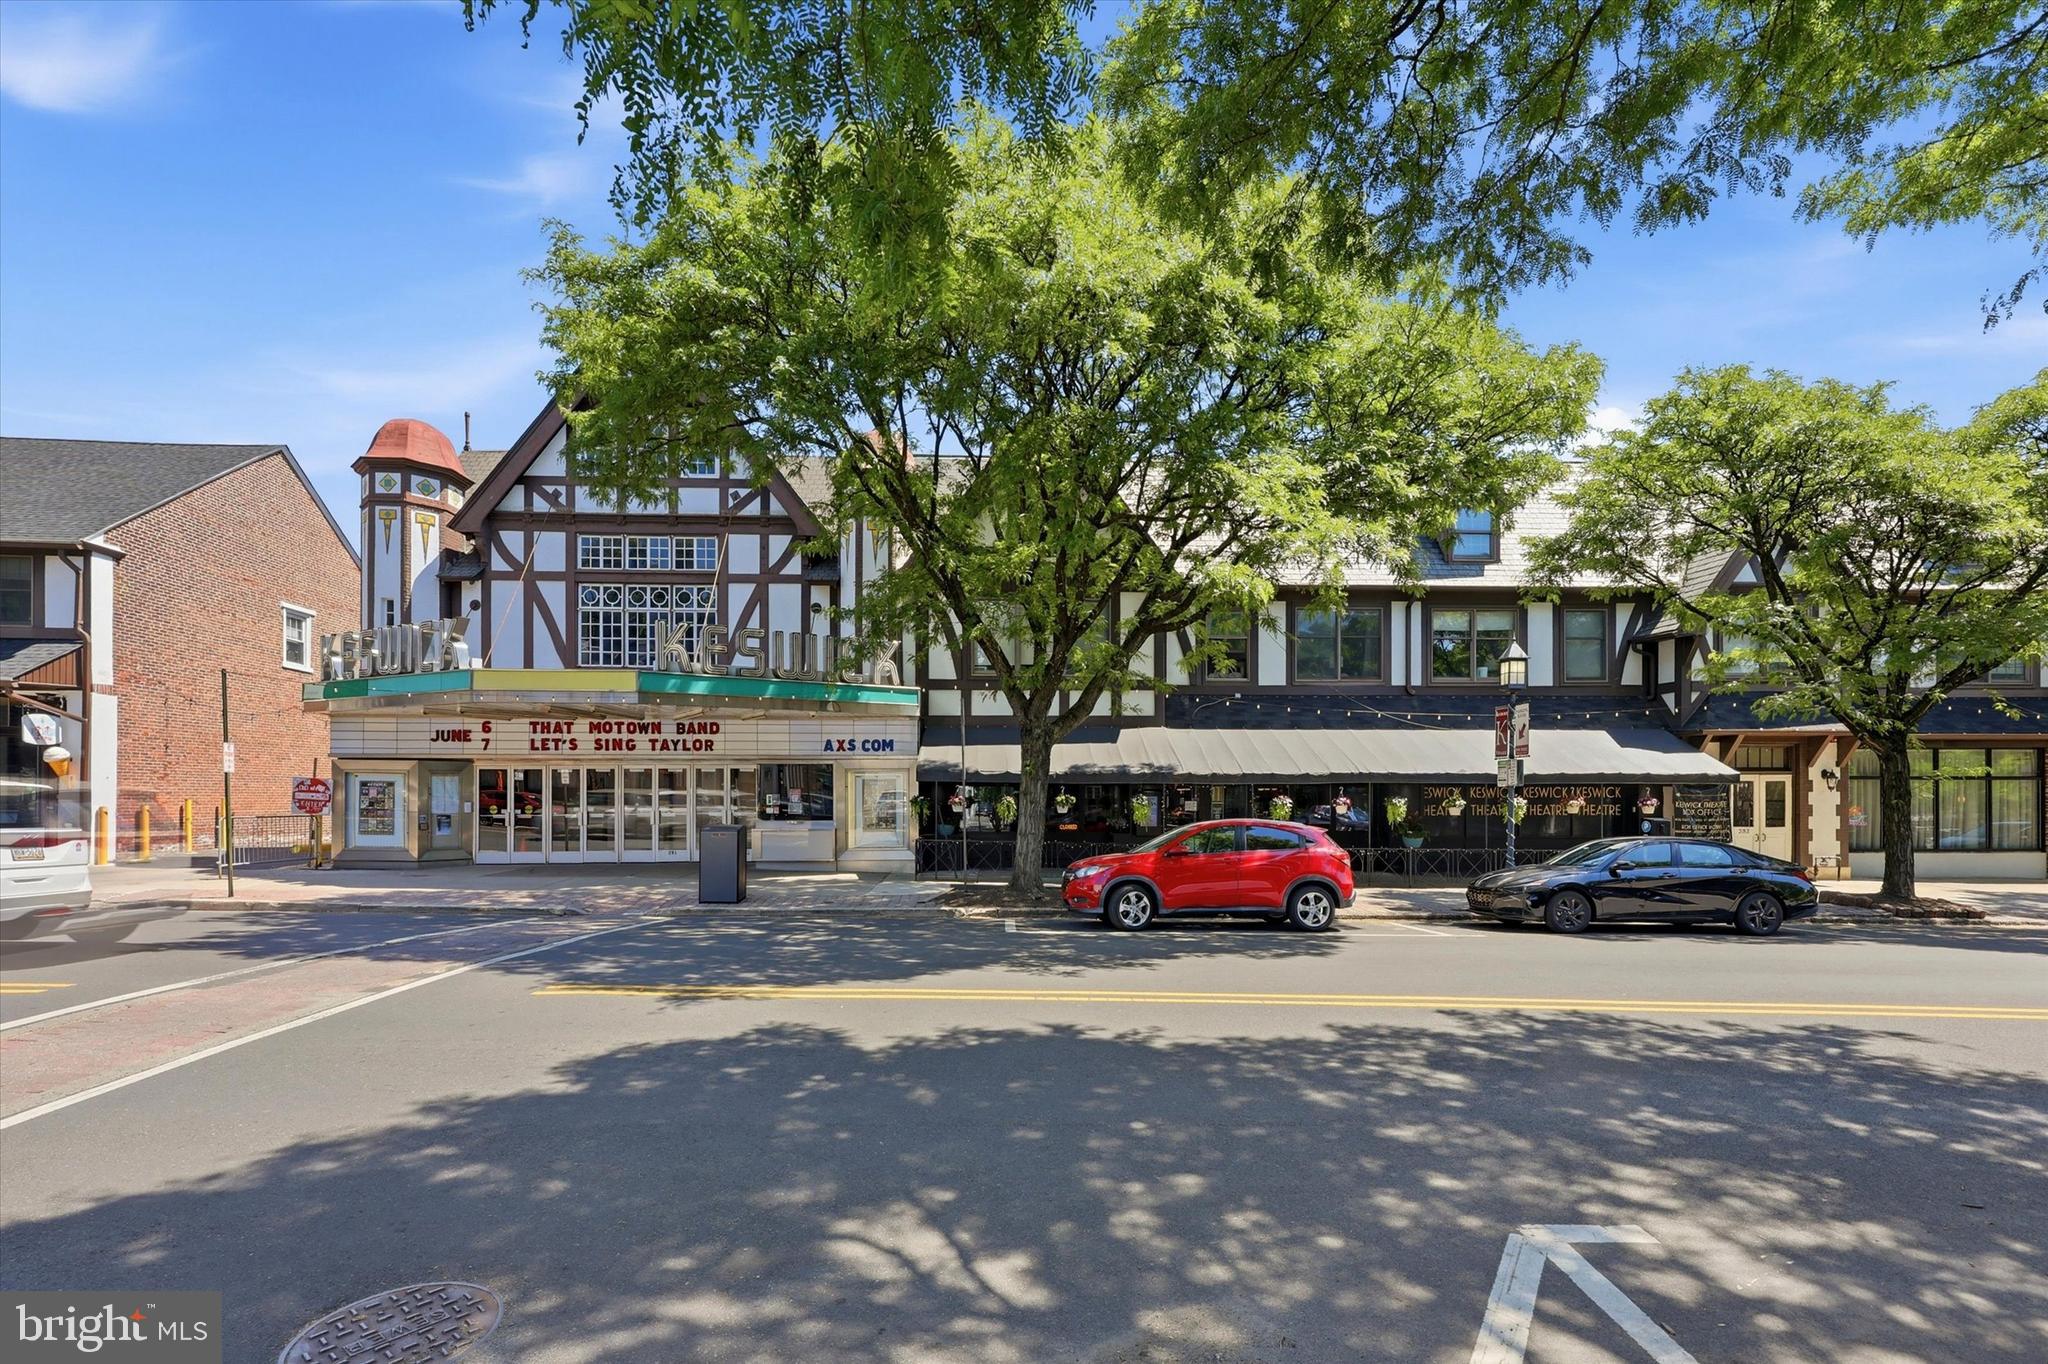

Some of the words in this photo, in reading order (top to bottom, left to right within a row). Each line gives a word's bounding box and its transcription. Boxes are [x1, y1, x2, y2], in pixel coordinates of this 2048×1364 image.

[320, 616, 470, 683] KESWICK
[655, 618, 901, 687] KESWICK
[481, 720, 492, 734] 6
[529, 720, 574, 735] THAT
[588, 721, 662, 735] MOTOWN
[676, 721, 720, 735] BAND
[430, 729, 472, 743] JUNE
[481, 738, 490, 751] 7
[530, 738, 578, 751] LET'S
[594, 738, 637, 751] SING
[648, 738, 715, 752] TAYLOR
[823, 738, 857, 752] AXS
[1424, 786, 1462, 799] ESWICK
[1470, 786, 1507, 799] KESWIC
[1523, 786, 1568, 799] KESWICK
[1576, 786, 1621, 799] KESWICK
[1529, 804, 1568, 816] HEATRE
[1583, 804, 1621, 816] HEATRE
